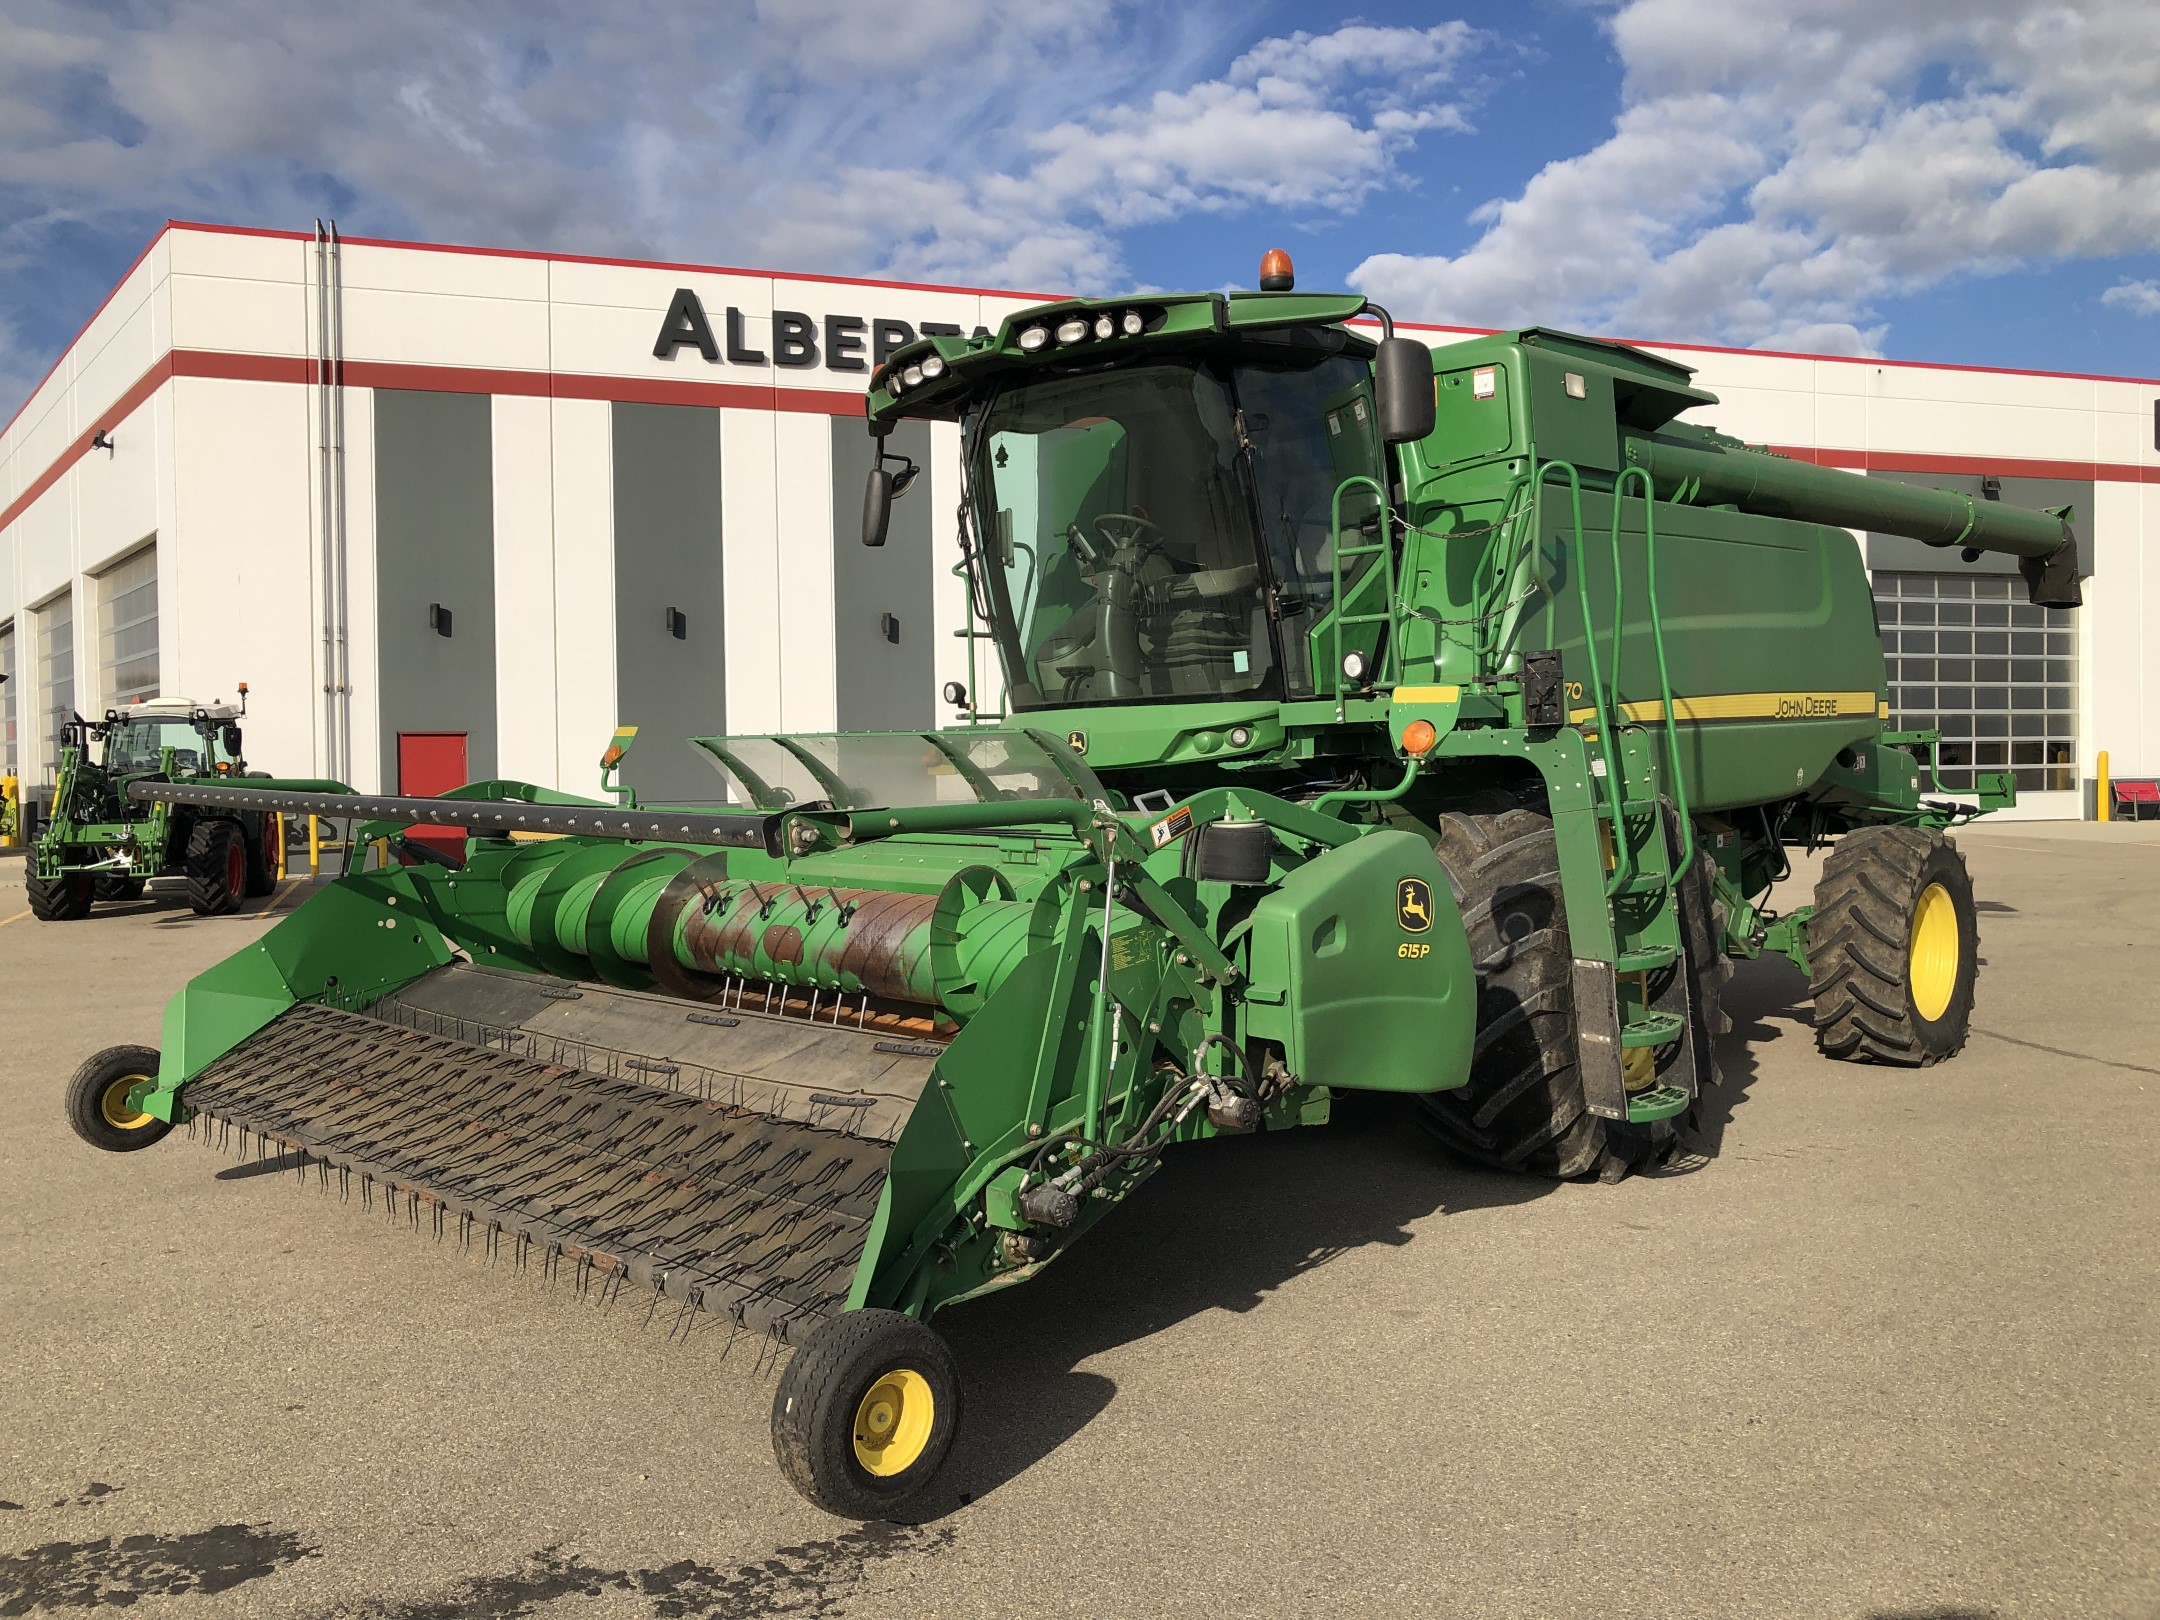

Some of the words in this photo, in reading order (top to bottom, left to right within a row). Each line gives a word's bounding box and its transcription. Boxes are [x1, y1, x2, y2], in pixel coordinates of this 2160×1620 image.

[653, 288, 992, 369] ALBER
[1564, 682, 1582, 700] 70
[1774, 696, 1804, 718] JOHN
[1805, 696, 1838, 717] DEERE
[1397, 942, 1431, 959] 615P
